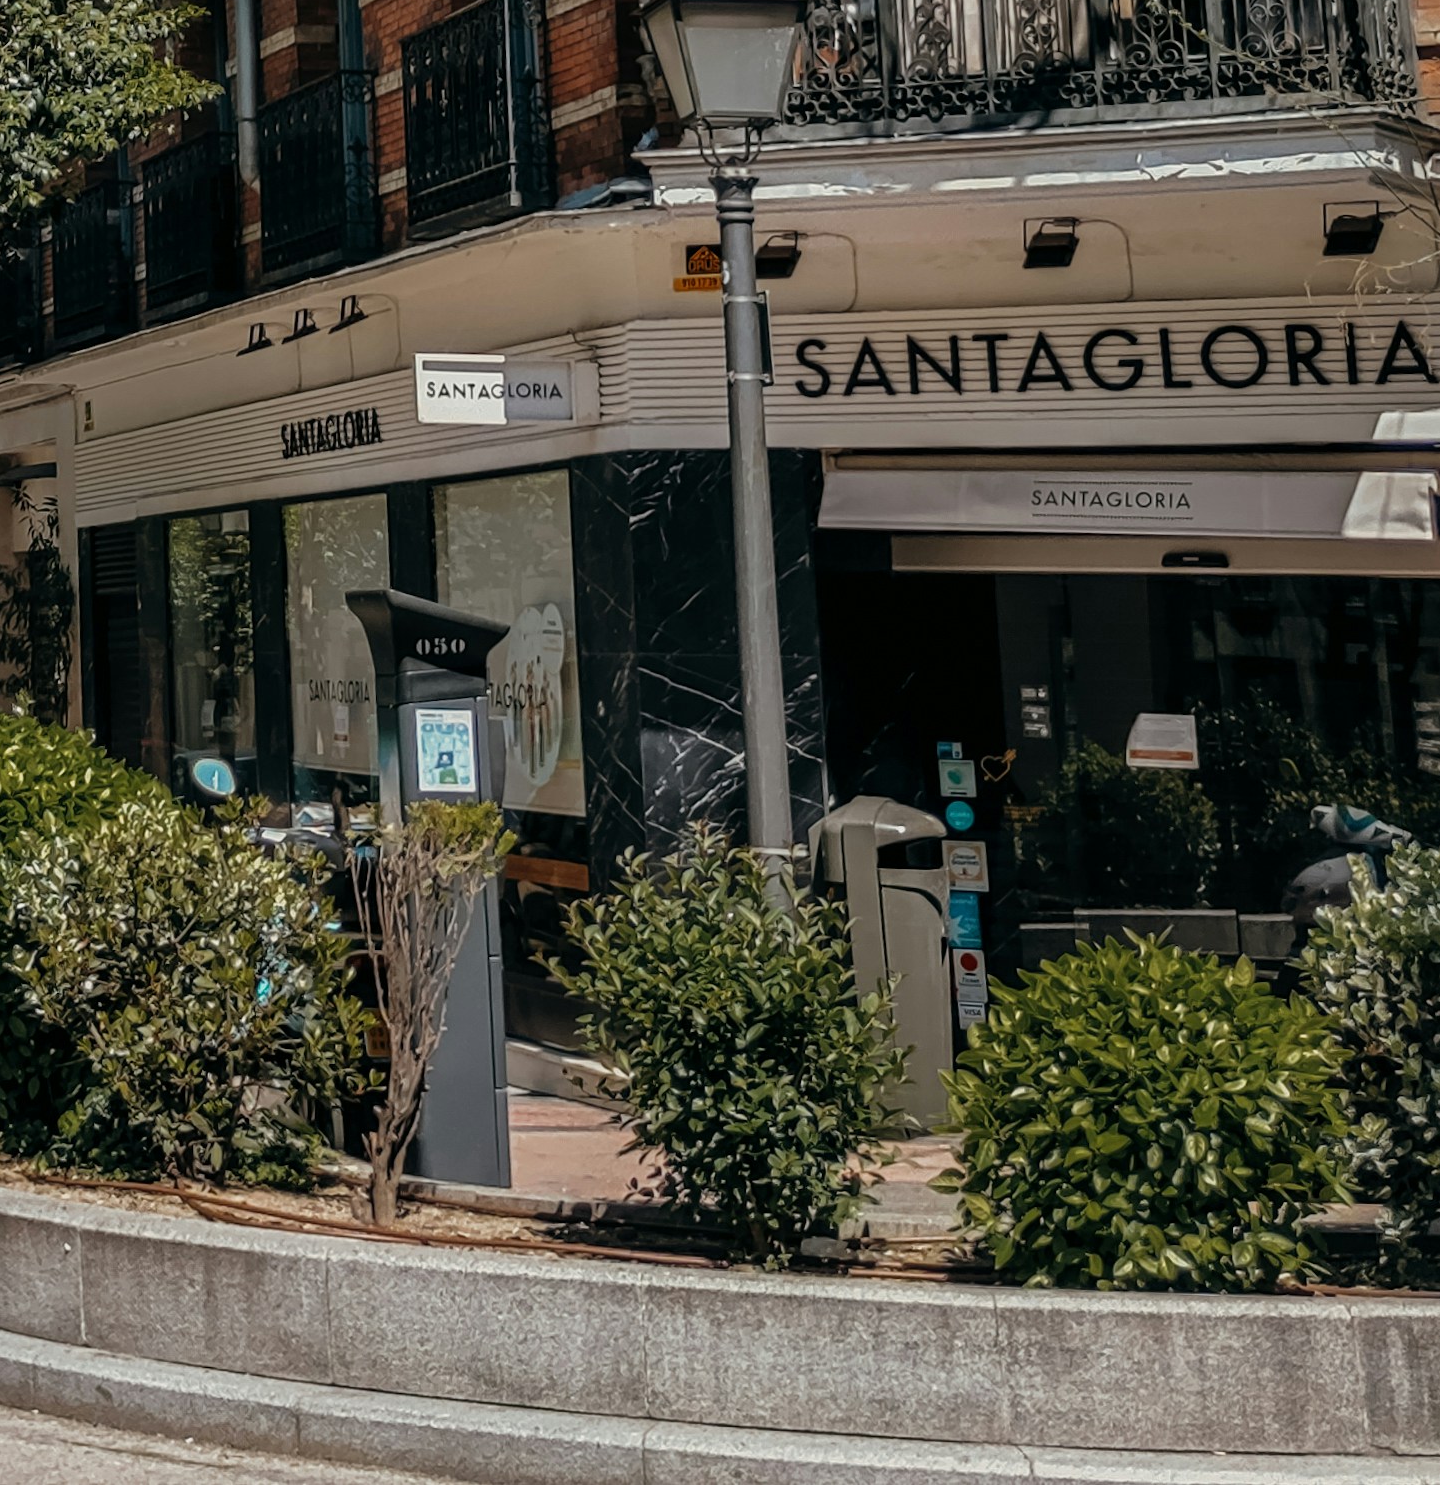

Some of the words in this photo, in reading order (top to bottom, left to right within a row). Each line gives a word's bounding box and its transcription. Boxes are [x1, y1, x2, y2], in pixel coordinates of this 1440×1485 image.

[795, 320, 1440, 398] SANTAGLORIA
[426, 381, 563, 399] SANTAGLORIA
[281, 407, 383, 459] SANTAGLORIA
[1030, 489, 1191, 510] SANTAGLORIA
[416, 638, 466, 655] 050
[309, 679, 370, 703] SANTAGLORIA
